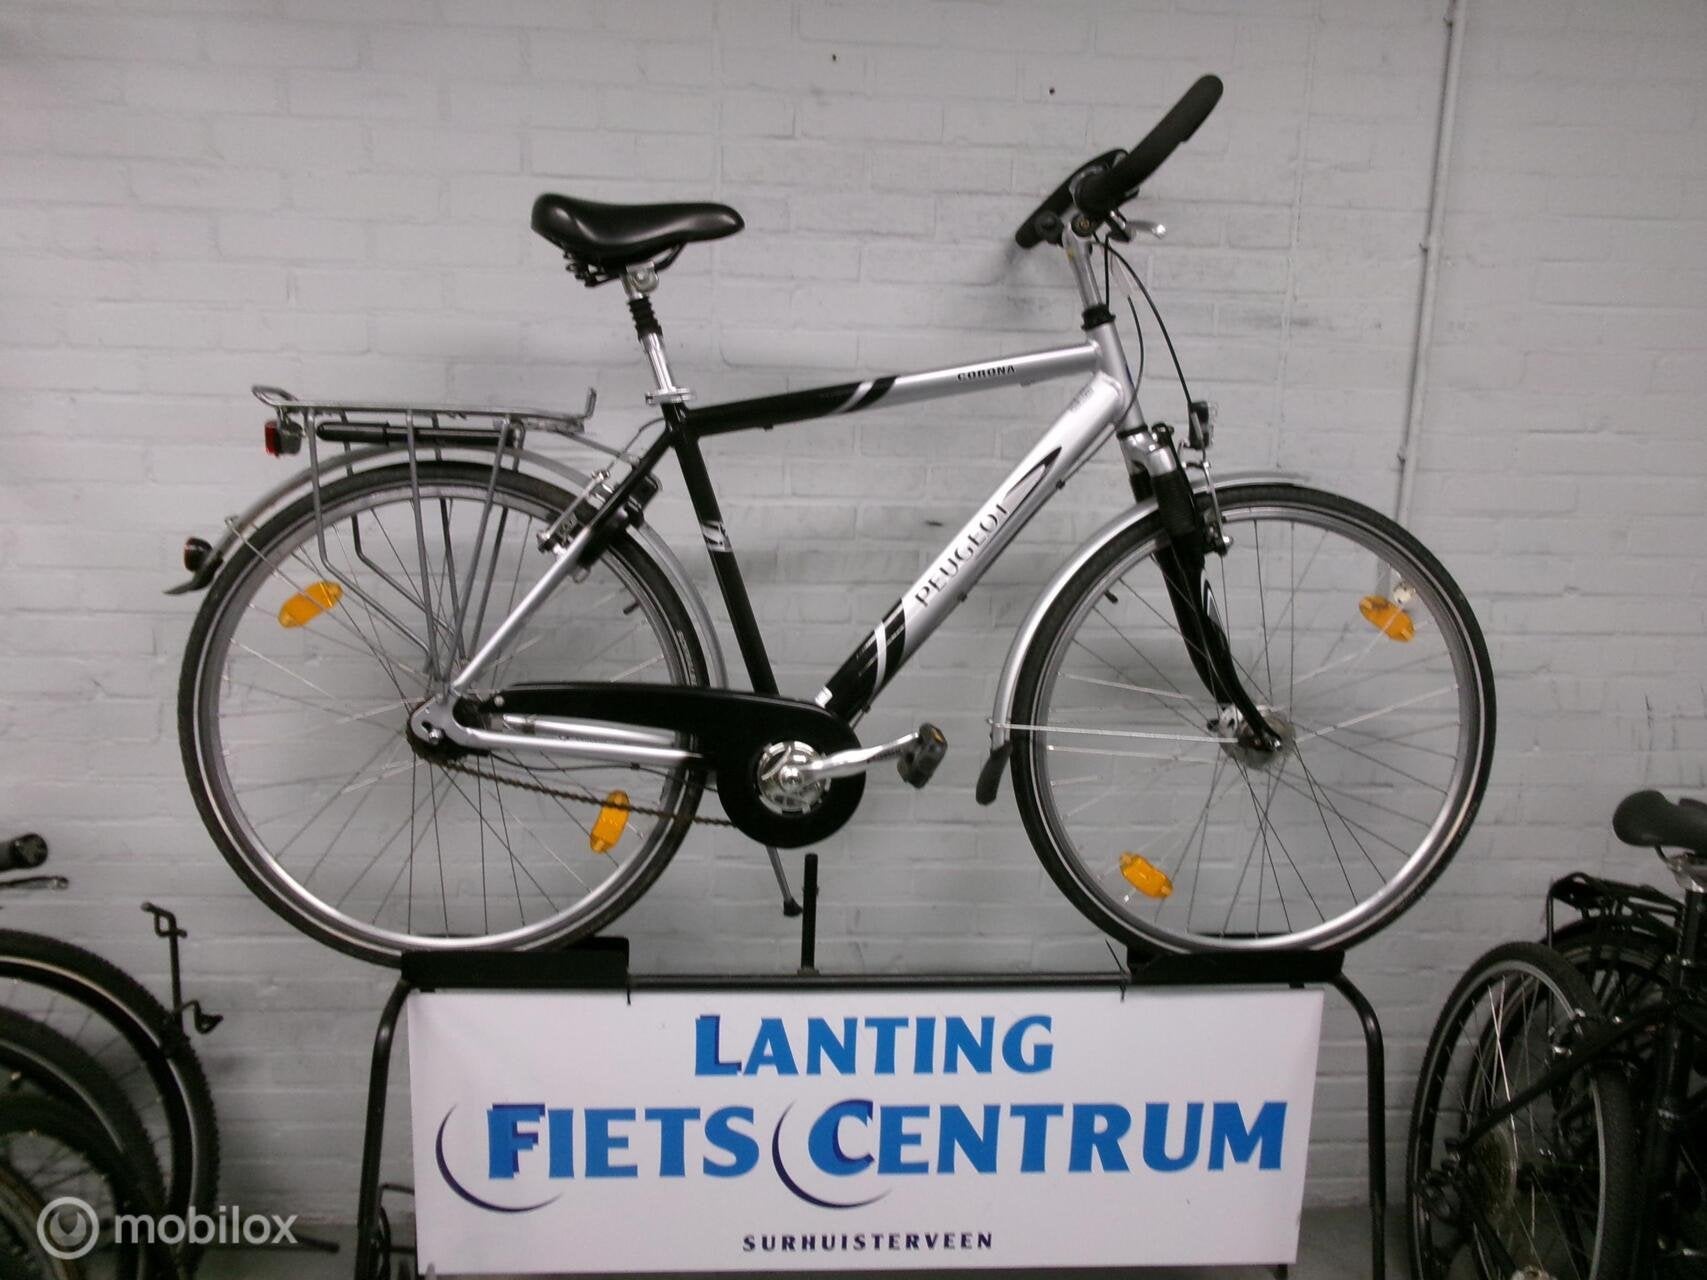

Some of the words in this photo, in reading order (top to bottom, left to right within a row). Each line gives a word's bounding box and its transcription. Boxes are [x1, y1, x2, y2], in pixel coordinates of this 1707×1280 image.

[957, 364, 1016, 382] CORONA
[695, 1014, 1054, 1077] LANTING
[486, 1102, 760, 1180] FIETS
[807, 1099, 1288, 1177] CENTRUM
[742, 1232, 993, 1252] SURHUISTERVEEN
